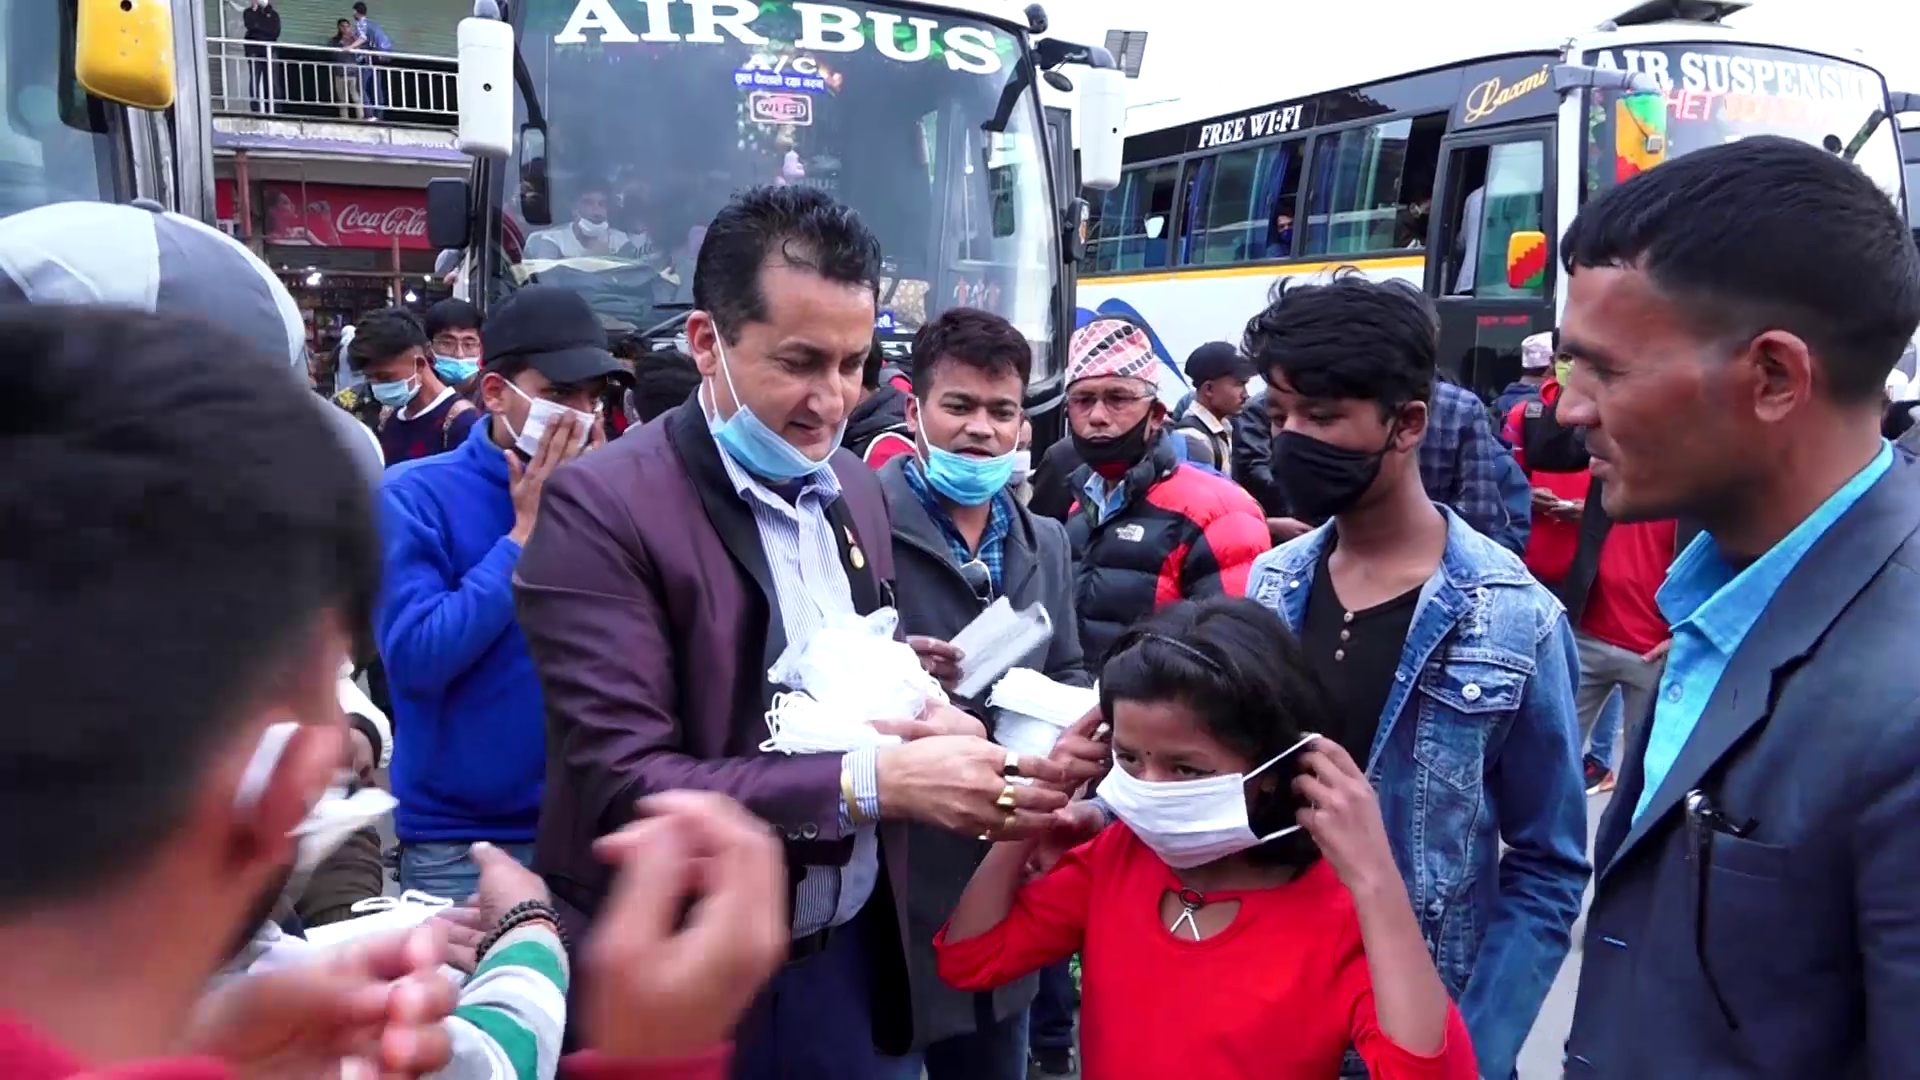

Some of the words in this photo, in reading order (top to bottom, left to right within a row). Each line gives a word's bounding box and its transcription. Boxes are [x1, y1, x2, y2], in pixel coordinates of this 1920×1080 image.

[554, 0, 770, 45] AIR
[792, 2, 1002, 74] BUS
[742, 54, 818, 75] A/C
[1463, 64, 1550, 124] Laxmi
[1198, 121, 1246, 149] FREE
